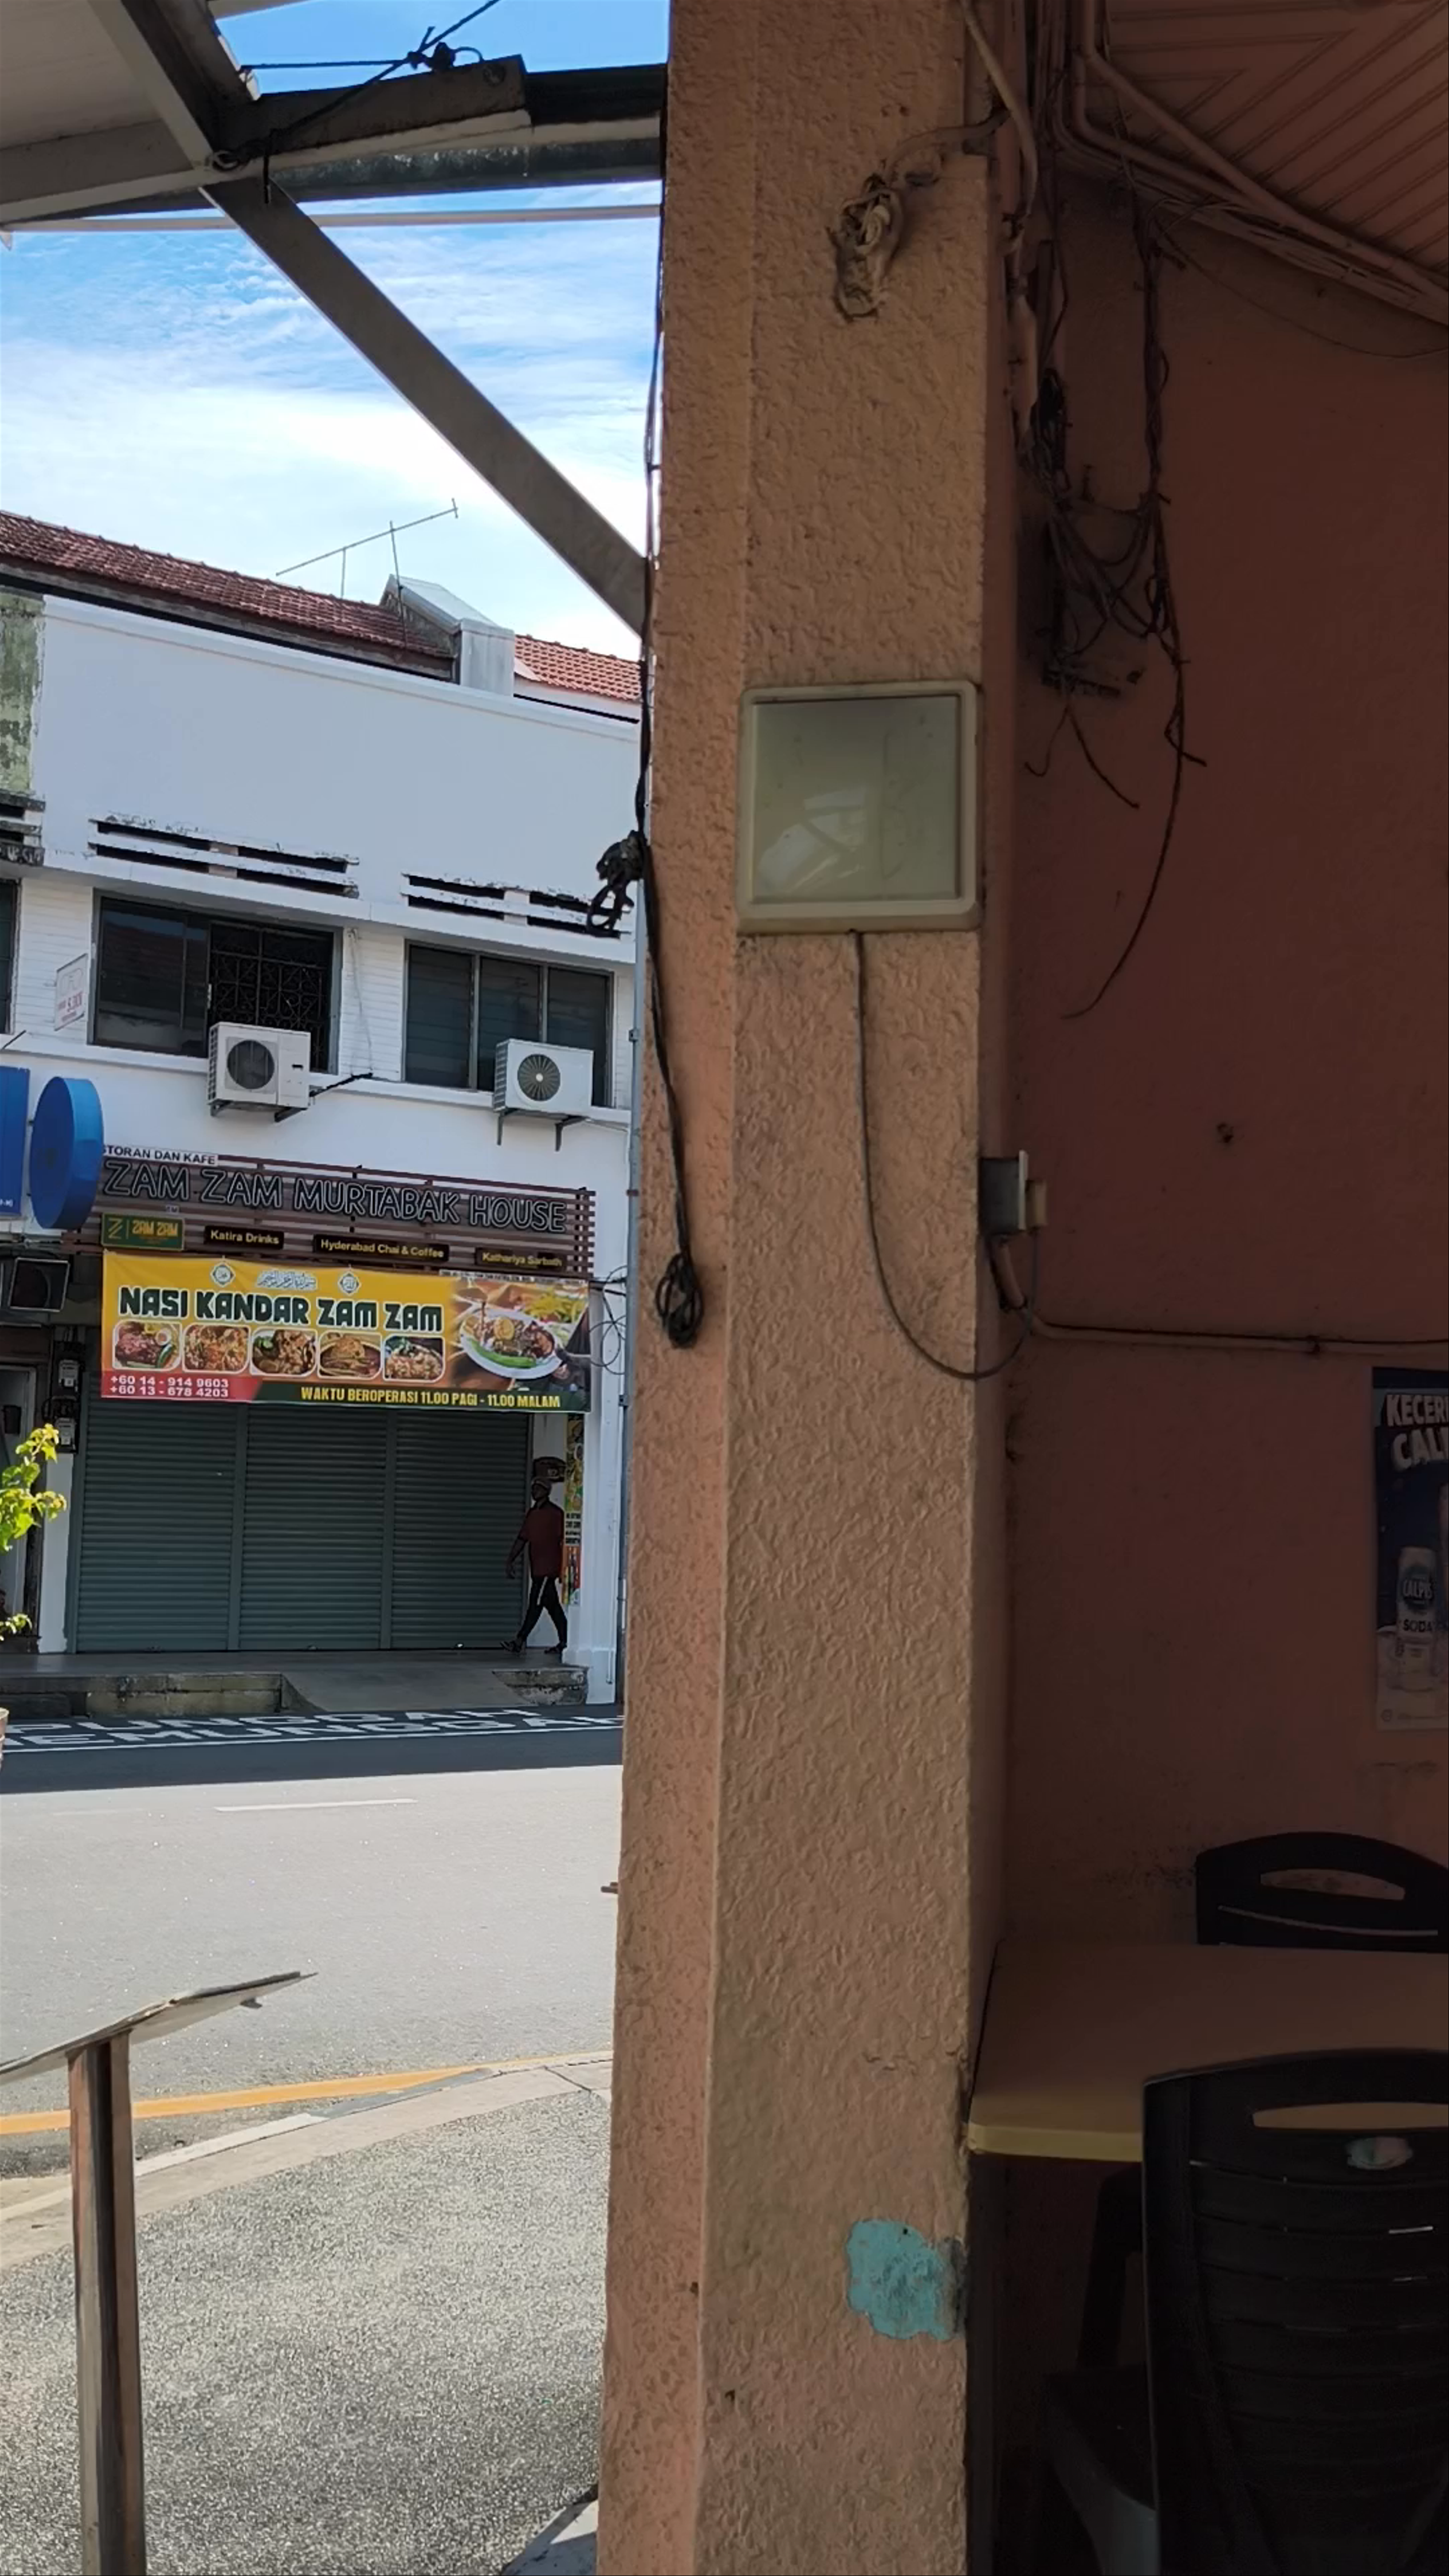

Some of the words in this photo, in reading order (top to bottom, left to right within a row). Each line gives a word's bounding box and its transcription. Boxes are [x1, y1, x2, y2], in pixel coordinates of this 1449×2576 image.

[155, 1150, 180, 1161] DAN
[184, 1153, 215, 1164] KAFE
[104, 1159, 189, 1200] ZAM
[200, 1168, 283, 1208] ZAM
[294, 1177, 461, 1224] MURTABAK
[469, 1194, 567, 1232] HOUSE
[211, 1229, 243, 1242] Katira
[246, 1232, 279, 1244] Drinks
[321, 1239, 375, 1251] Hyderabad
[377, 1244, 400, 1254] Chai
[401, 1246, 409, 1255] &
[411, 1247, 444, 1258] Coffee
[120, 1287, 188, 1317] NASI
[196, 1291, 309, 1324] KANDAR
[318, 1299, 377, 1328] ZAM
[385, 1304, 442, 1331] ZAM
[110, 1375, 135, 1385] +60
[140, 1376, 155, 1386] 14
[168, 1377, 192, 1387] 914
[196, 1378, 229, 1387] 9603
[110, 1385, 135, 1395] +60
[140, 1386, 155, 1395] 13
[168, 1387, 192, 1396] 678
[196, 1388, 228, 1397] 4203
[301, 1387, 345, 1401] WAKTU
[348, 1388, 418, 1403] BEROPERASI
[421, 1392, 449, 1404] 11.00
[452, 1393, 478, 1406] PAGI
[487, 1394, 515, 1407] 11.00
[517, 1395, 560, 1407] MALAM
[1403, 1619, 1432, 1632] SODA
